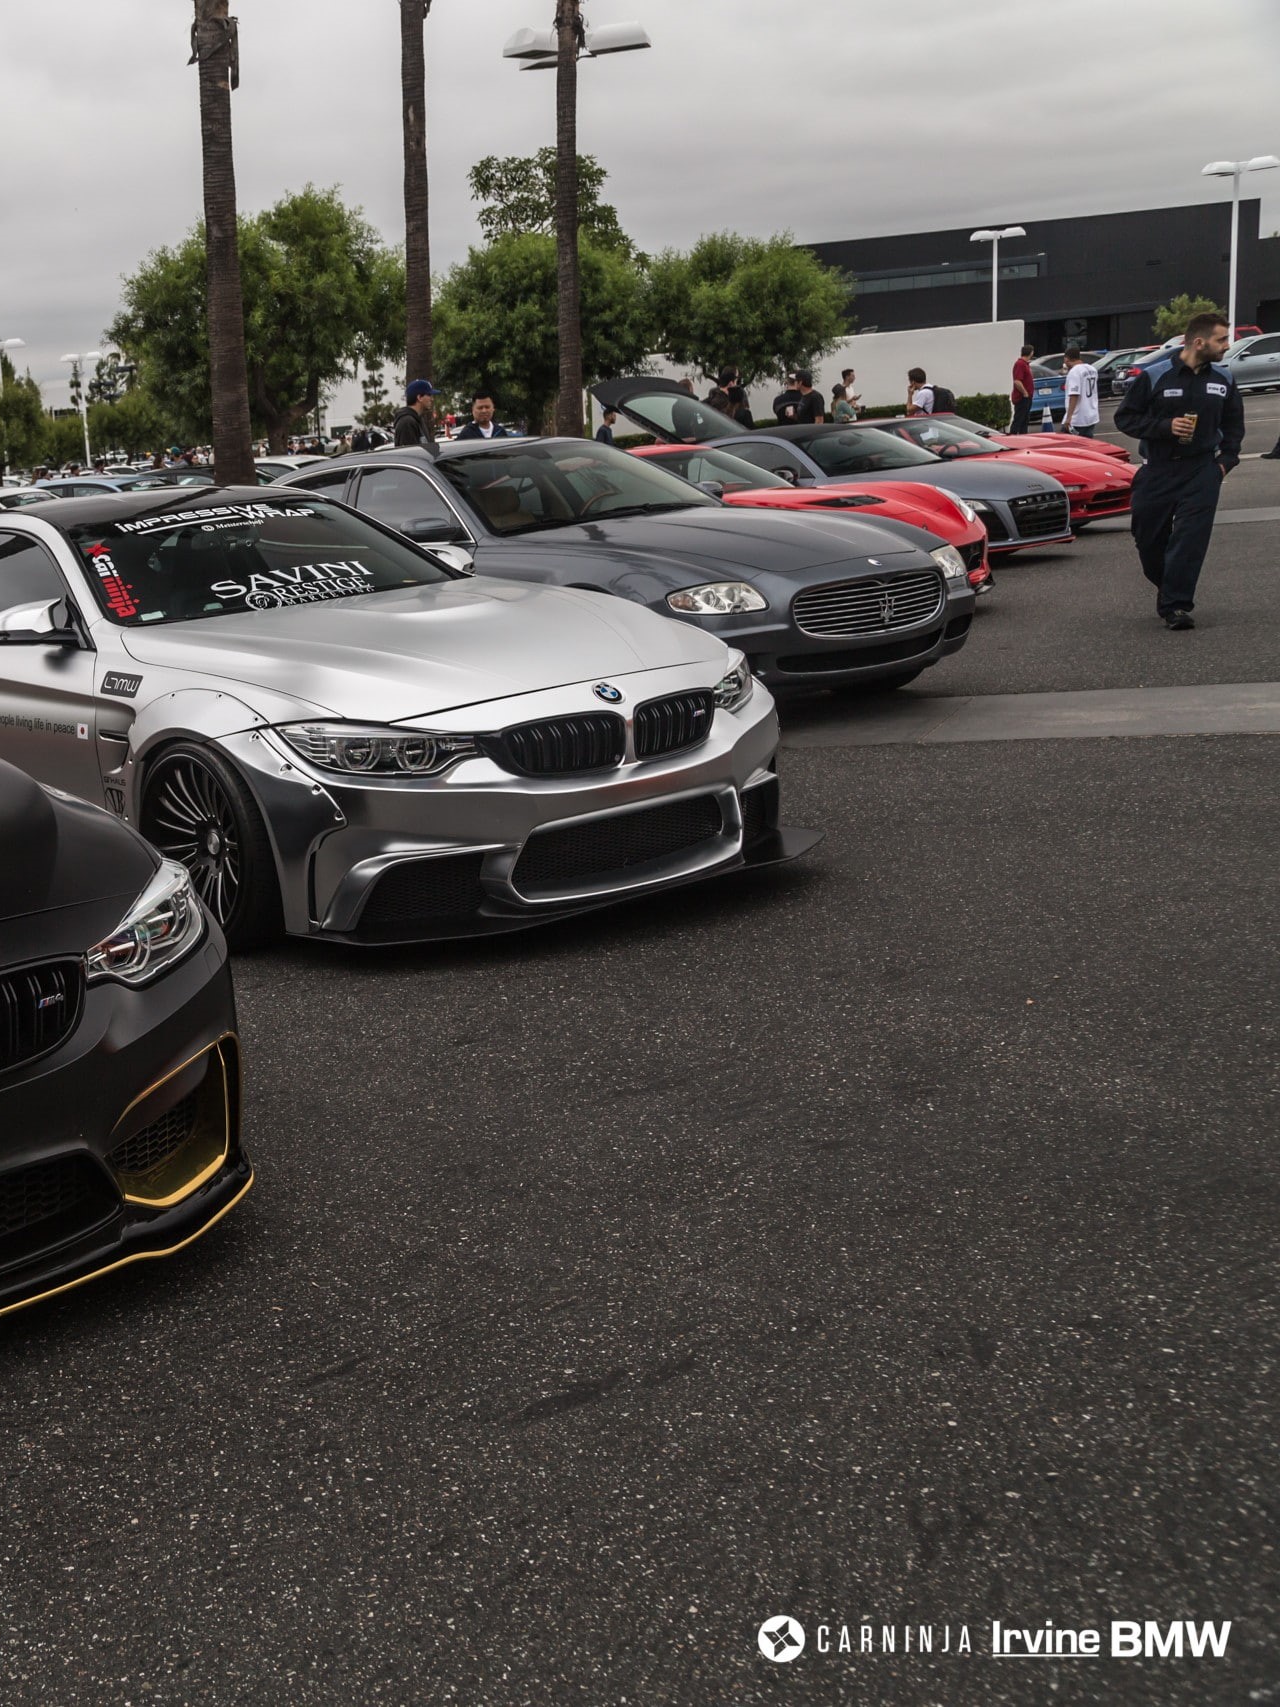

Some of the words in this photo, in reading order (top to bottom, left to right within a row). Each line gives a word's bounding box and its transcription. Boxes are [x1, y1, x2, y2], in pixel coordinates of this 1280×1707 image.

[239, 508, 315, 519] WRAP
[210, 560, 374, 599] SAVINI
[15, 715, 33, 732] living
[33, 717, 44, 730] life
[45, 719, 52, 731] in
[53, 721, 75, 735] peace
